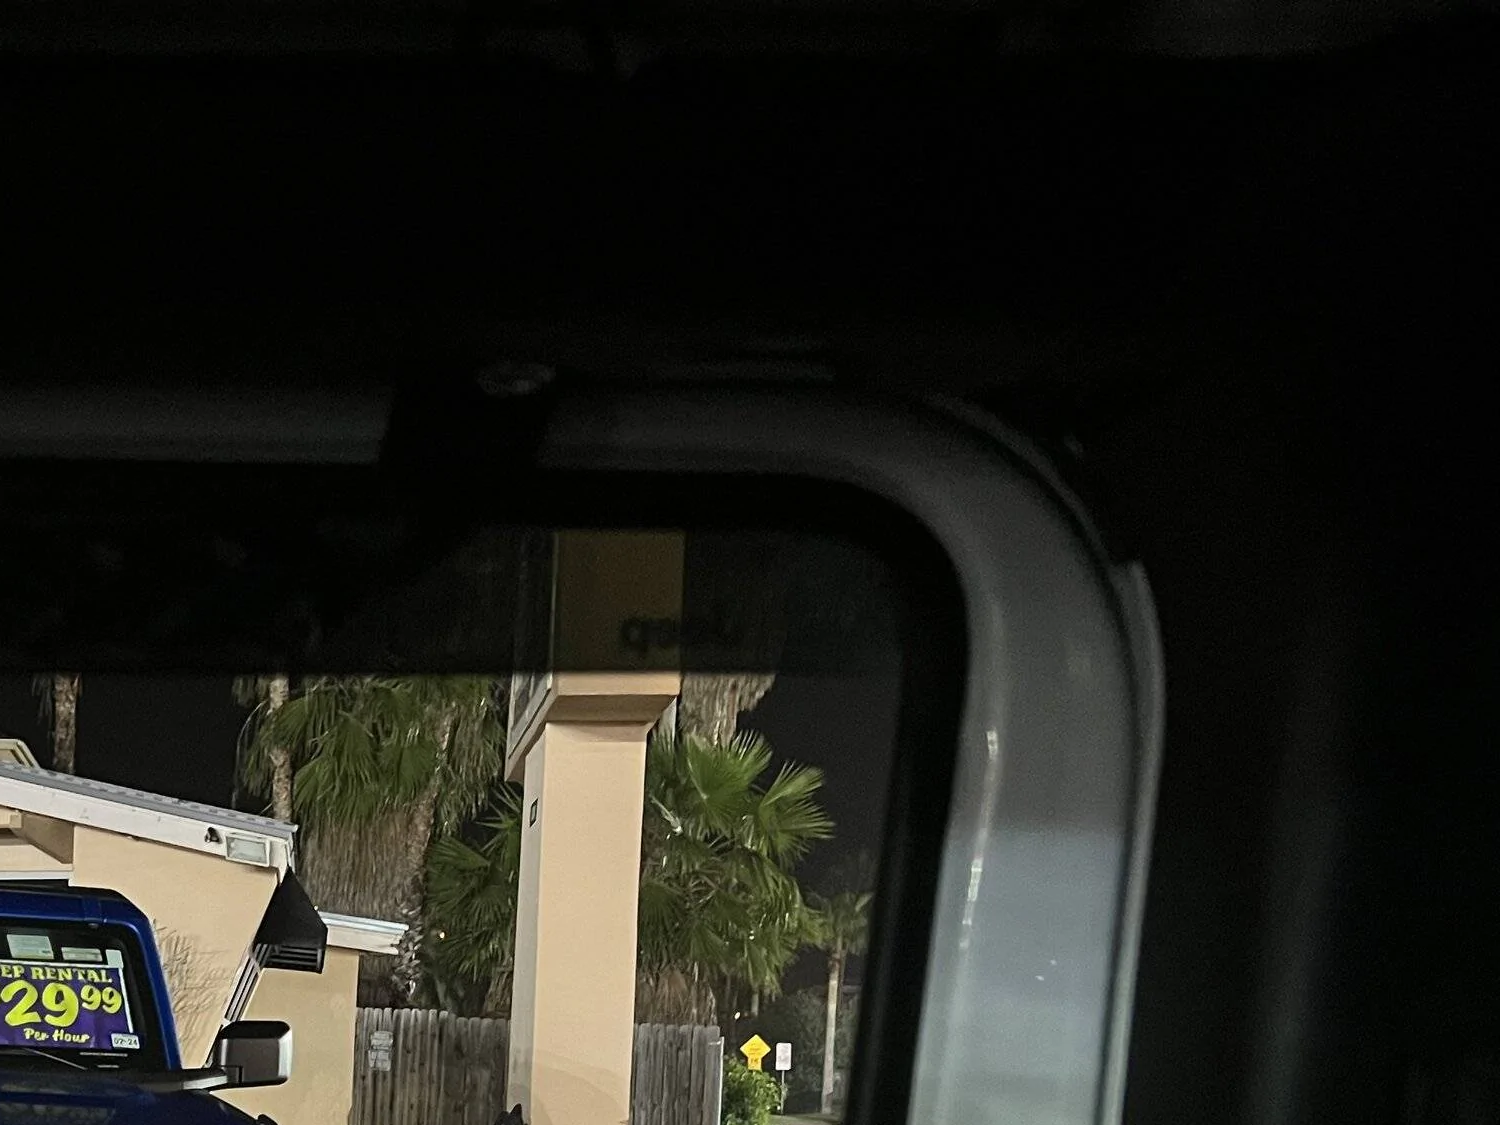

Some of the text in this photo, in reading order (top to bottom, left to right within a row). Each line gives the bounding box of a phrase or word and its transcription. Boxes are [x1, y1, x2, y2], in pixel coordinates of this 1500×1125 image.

[31, 967, 113, 983] RENTAL
[23, 1028, 91, 1043] Per Hour
